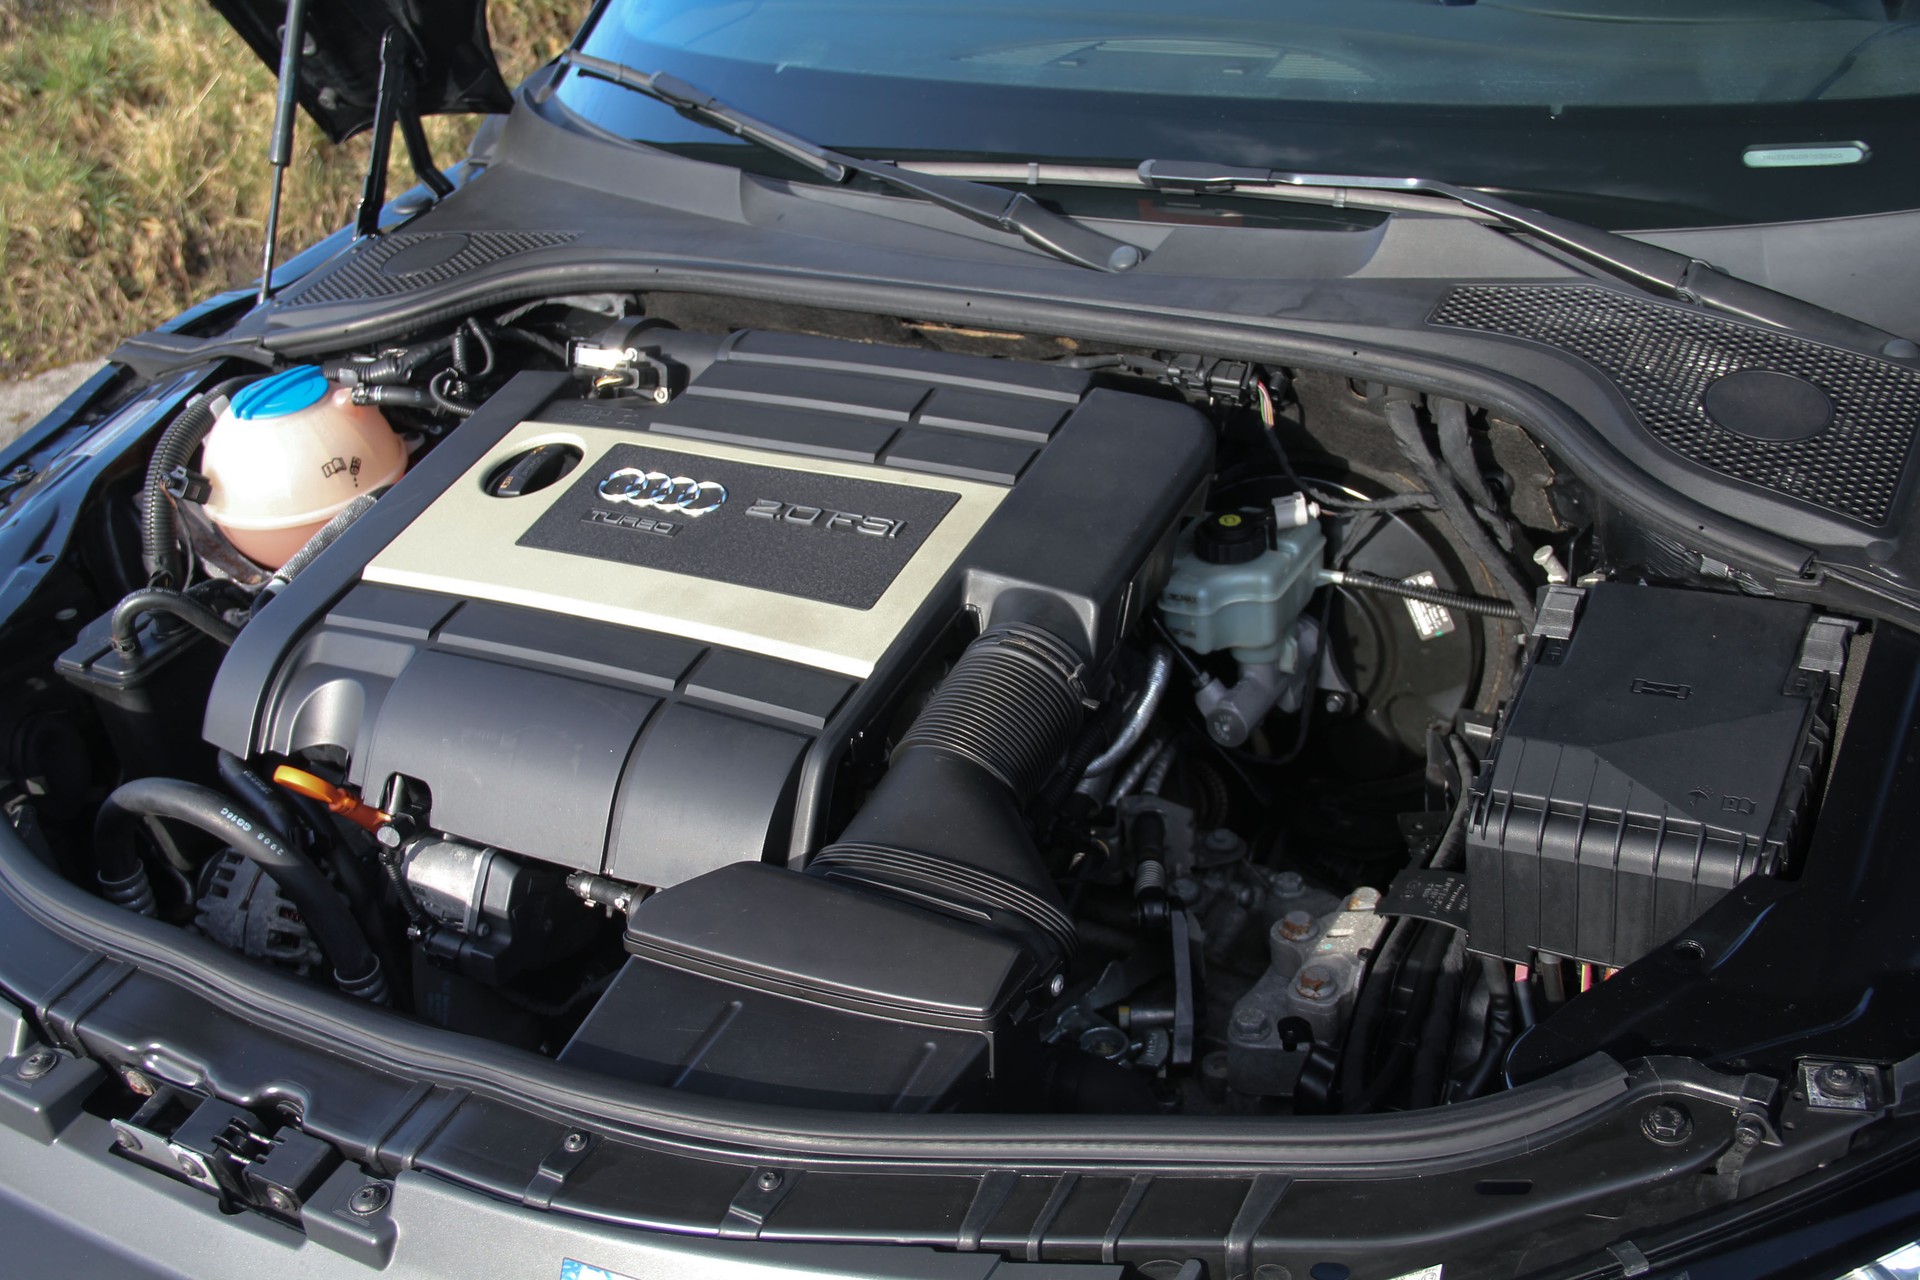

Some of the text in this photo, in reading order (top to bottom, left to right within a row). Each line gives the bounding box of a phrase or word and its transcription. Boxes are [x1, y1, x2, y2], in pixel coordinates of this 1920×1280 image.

[592, 510, 674, 534] TURBO
[745, 499, 905, 539] 2.0 FSI
